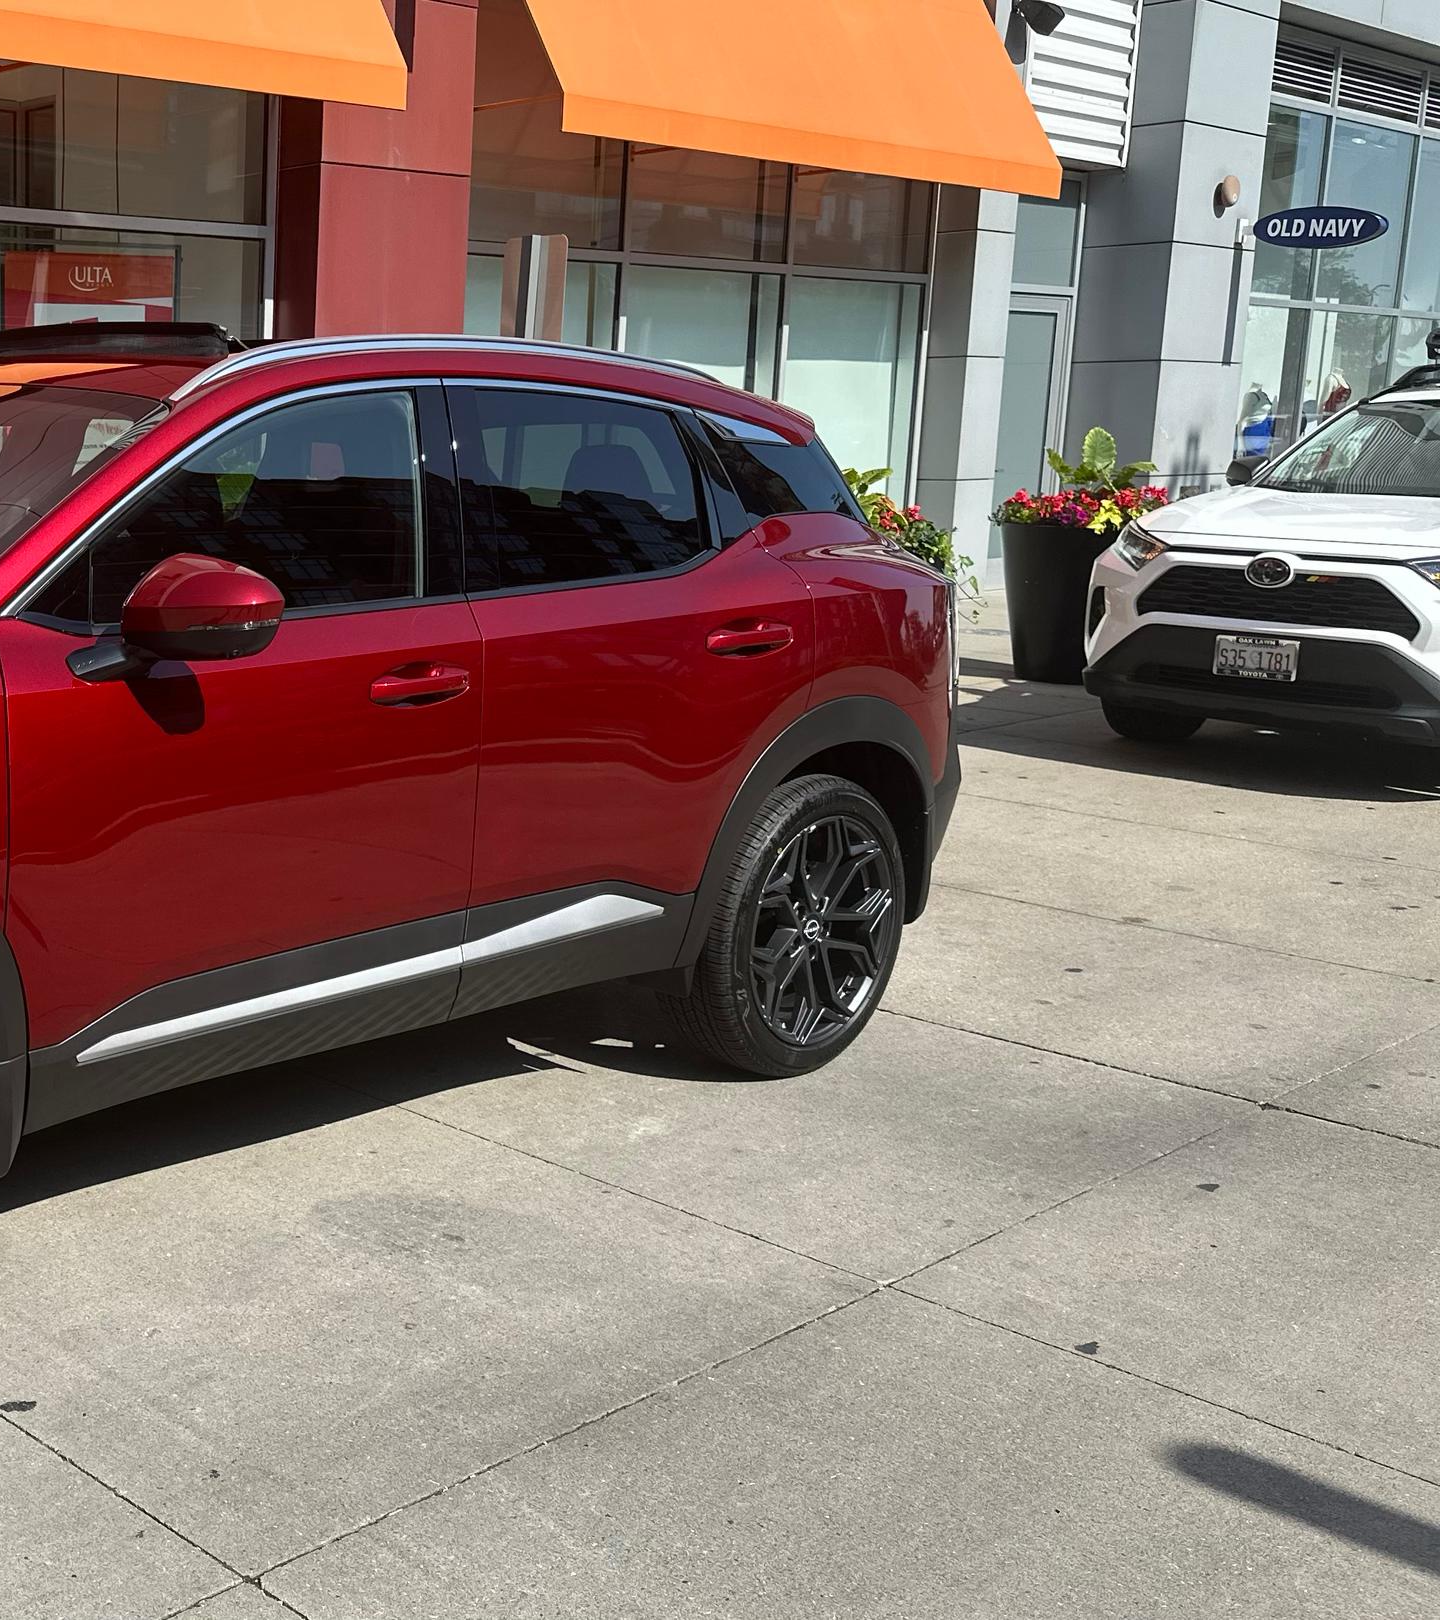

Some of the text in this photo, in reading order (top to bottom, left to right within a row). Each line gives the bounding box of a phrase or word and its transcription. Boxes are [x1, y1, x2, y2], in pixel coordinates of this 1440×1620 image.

[1266, 218, 1366, 238] OLD NAVY
[74, 265, 113, 284] ULTA
[1238, 637, 1253, 645] OAK
[1238, 670, 1268, 678] TOYOTA
